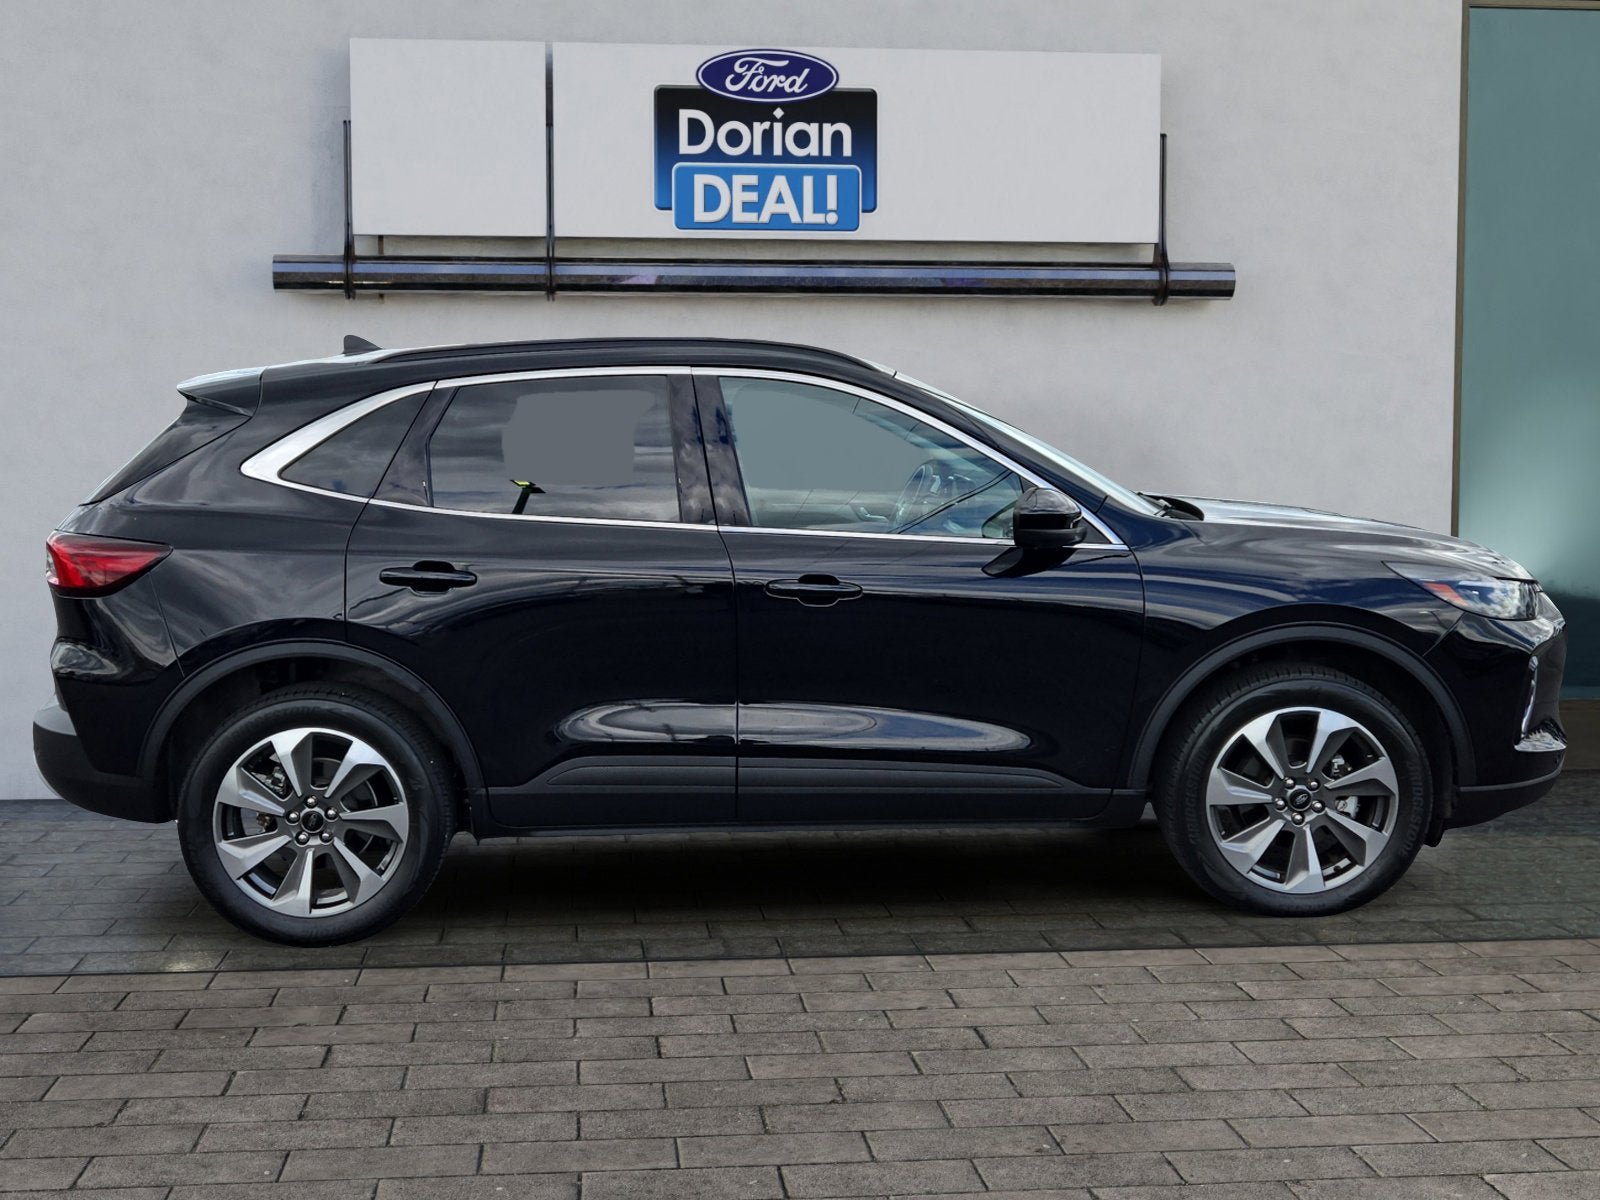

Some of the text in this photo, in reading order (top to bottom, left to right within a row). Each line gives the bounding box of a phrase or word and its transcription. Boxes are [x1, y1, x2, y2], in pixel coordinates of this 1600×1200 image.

[725, 57, 810, 93] Ford
[678, 107, 852, 157] Dorian
[693, 173, 839, 225] DEAL!
